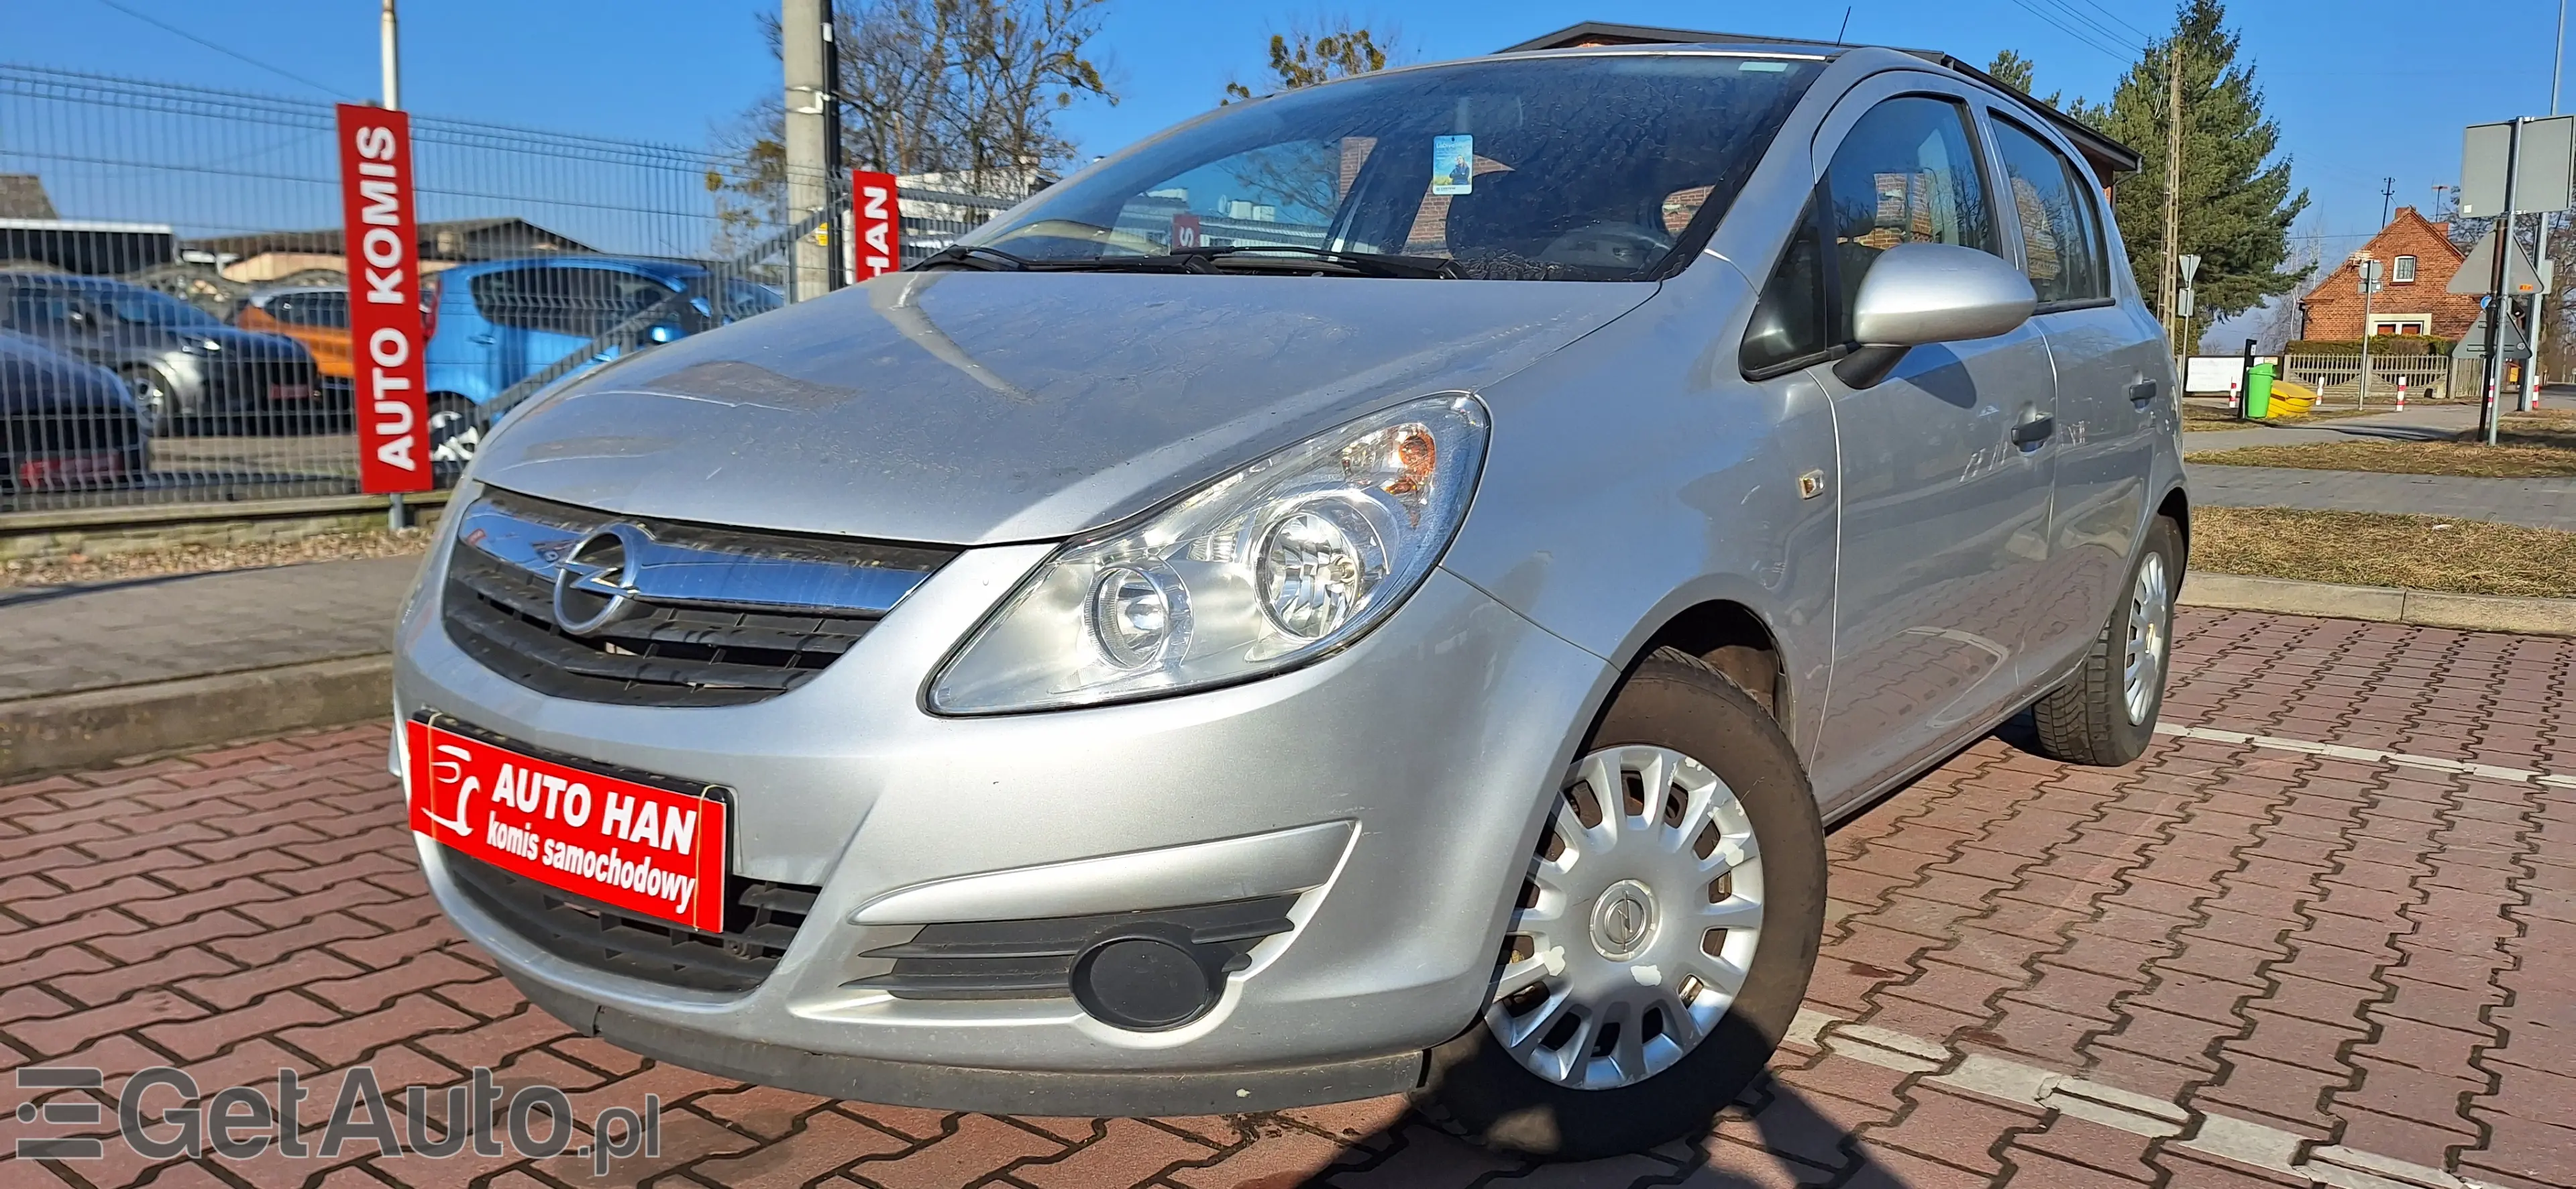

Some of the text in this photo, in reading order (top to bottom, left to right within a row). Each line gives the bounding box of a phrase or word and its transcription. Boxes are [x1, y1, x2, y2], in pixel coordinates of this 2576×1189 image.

[863, 186, 890, 280] HAN
[356, 126, 417, 471] AUTO KOMIS
[491, 762, 698, 855] AUTO HAN
[486, 811, 696, 914] komis samochodowy
